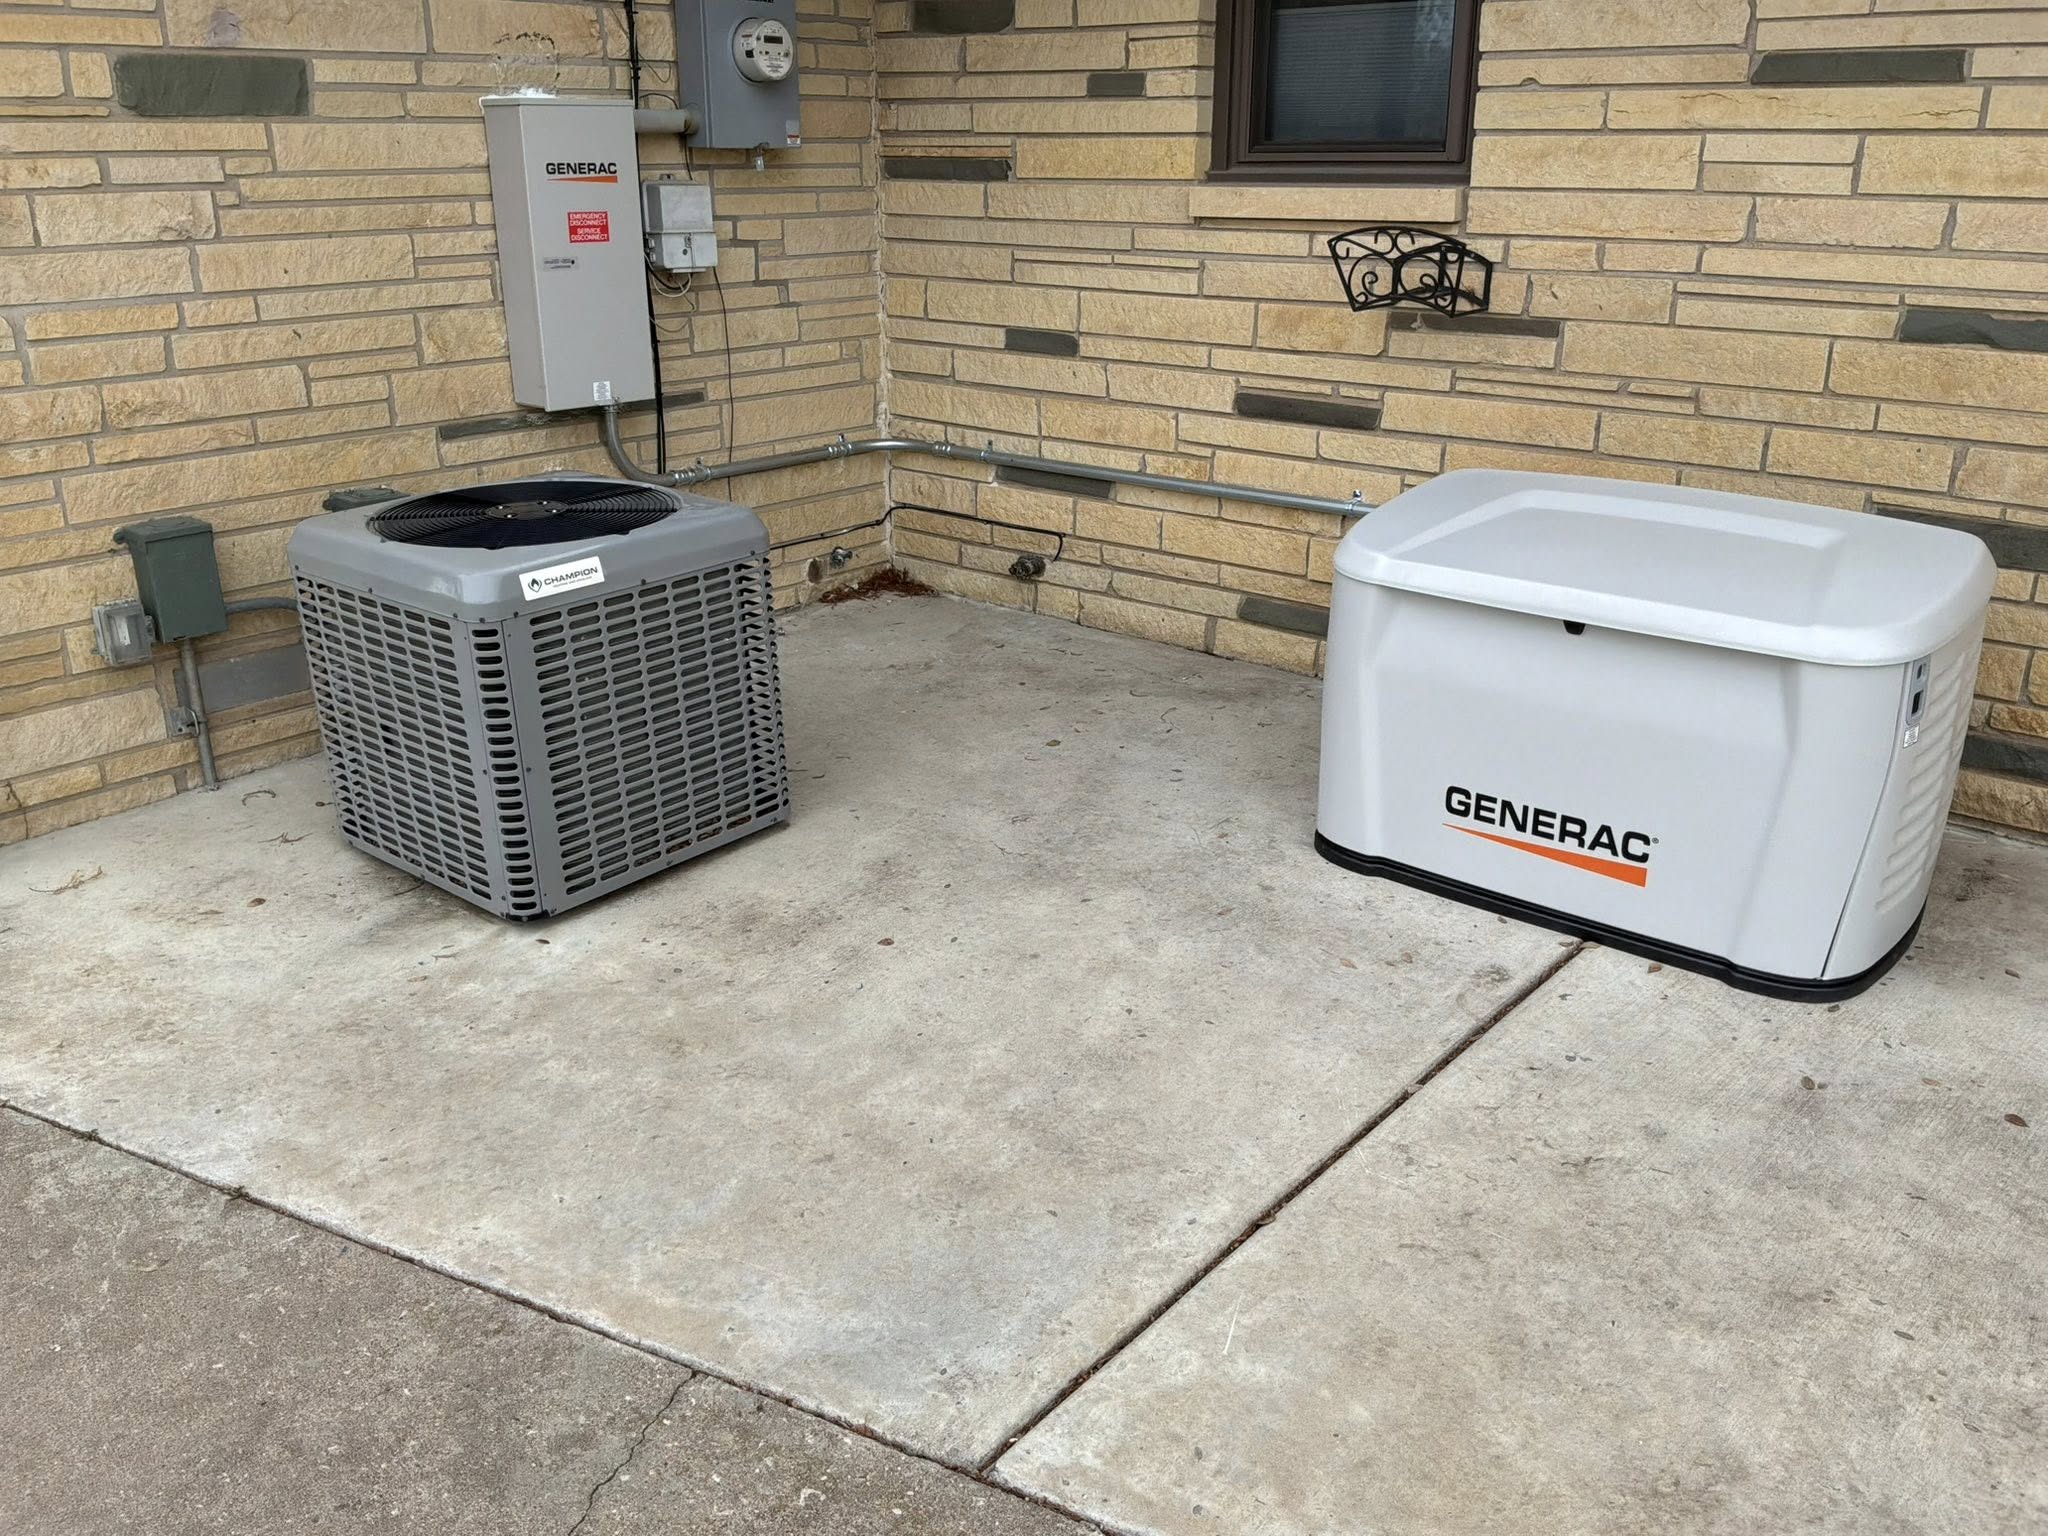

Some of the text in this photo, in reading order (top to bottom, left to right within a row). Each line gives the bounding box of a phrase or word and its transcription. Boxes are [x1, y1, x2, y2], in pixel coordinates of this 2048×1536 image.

[546, 162, 617, 175] GENERAC
[544, 567, 598, 585] CHAMPION
[1445, 785, 1651, 864] GENERAC
